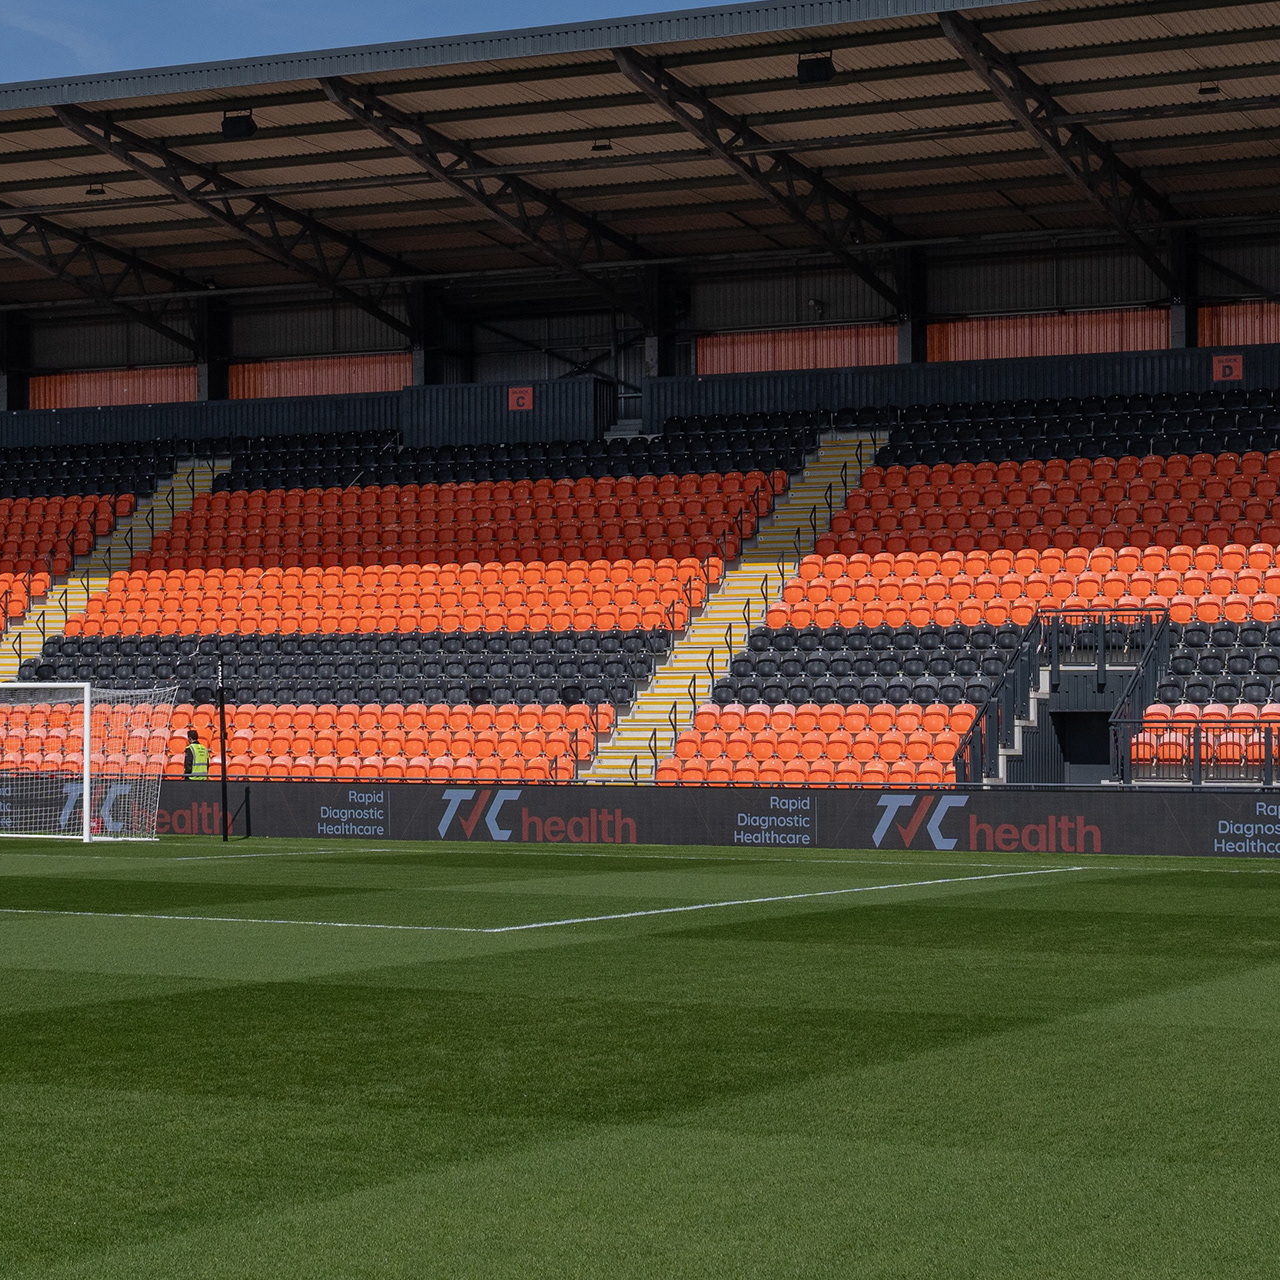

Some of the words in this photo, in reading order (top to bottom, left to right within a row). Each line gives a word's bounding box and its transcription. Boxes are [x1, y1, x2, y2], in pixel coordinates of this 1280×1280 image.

[1222, 365, 1234, 378] D
[516, 396, 525, 407] C
[348, 790, 385, 806] Rapid
[769, 795, 811, 812] Rapid
[320, 806, 385, 823] Diagnostic
[737, 812, 811, 830] Diagnostic
[317, 822, 385, 837] Healthcare
[521, 807, 637, 844] health
[733, 829, 811, 845] Healthcare
[969, 815, 1101, 853] health
